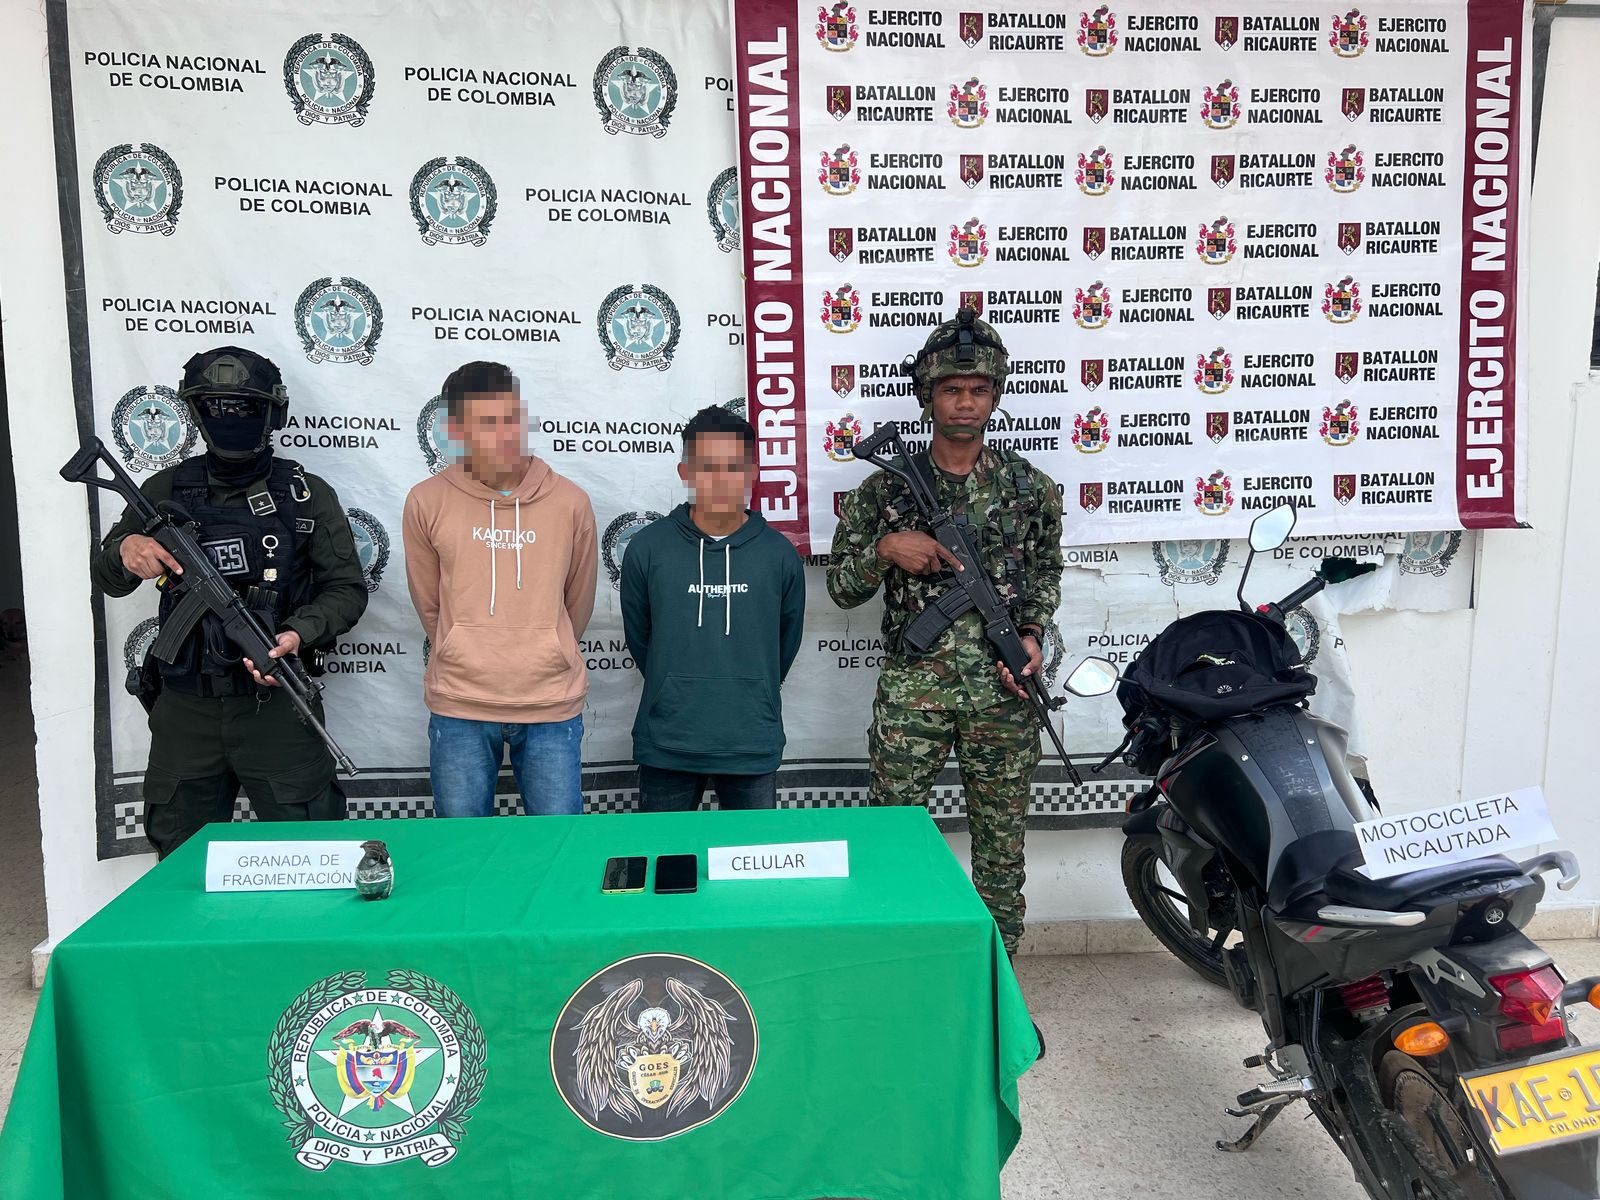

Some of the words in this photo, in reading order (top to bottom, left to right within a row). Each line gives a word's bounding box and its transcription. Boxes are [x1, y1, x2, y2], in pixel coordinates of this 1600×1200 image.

[868, 10, 943, 26] EJERCITO
[988, 13, 1066, 30] BATALLON
[1127, 15, 1199, 31] EJERCITO
[1243, 16, 1320, 31] BATALLON
[1378, 18, 1447, 32] EJERCITO
[866, 31, 946, 48] NACIONAL
[989, 35, 1064, 50] RICAURTE
[1124, 36, 1202, 52] NACIONAL
[1243, 36, 1317, 51] RICAURTE
[1375, 37, 1450, 53] NACIONAL
[84, 52, 161, 68] POLICIA
[167, 55, 266, 74] NACIONAL
[294, 45, 318, 75] REPUBLICA
[338, 46, 363, 76] COLOMBIA
[110, 73, 133, 87] DE
[139, 75, 244, 92] COLOMBIA
[404, 67, 477, 83] POLICIA
[483, 71, 577, 87] NACIONAL
[427, 88, 451, 101] DE
[457, 89, 555, 106] COLOMBIA
[856, 85, 936, 101] BATALLON
[998, 88, 1069, 102] EJERCITO
[1113, 89, 1191, 104] BATALLON
[1250, 89, 1321, 103] EJERCITO
[1369, 87, 1444, 103] BATALLON
[301, 93, 324, 112] POLICIA
[331, 94, 360, 114] NACIONAL
[857, 106, 934, 122] RICAURTE
[996, 108, 1072, 124] NACIONAL
[1113, 109, 1188, 124] RICAURTE
[1247, 109, 1323, 124] NACIONAL
[1369, 107, 1442, 123] RICAURTE
[748, 27, 791, 282] NACIONAL
[870, 153, 943, 169] EJERCITO
[988, 154, 1065, 170] BATALLON
[1124, 154, 1195, 170] EJERCITO
[1239, 154, 1316, 169] BATALLON
[1375, 152, 1444, 167] EJERCITO
[1471, 37, 1513, 272] NACIONAL
[215, 177, 290, 193] POLICIA
[295, 179, 392, 197] NACIONAL
[868, 174, 946, 190] NACIONAL
[989, 173, 1063, 189] RICAURTE
[1121, 175, 1198, 191] NACIONAL
[1240, 172, 1313, 188] RICAURTE
[1371, 172, 1447, 187] NACIONAL
[526, 188, 594, 203] POLICIA
[601, 189, 691, 206] NACIONAL
[240, 199, 265, 211] DE
[271, 199, 371, 216] COLOMBIA
[549, 208, 571, 222] DE
[577, 208, 671, 224] COLOMBIA
[857, 226, 936, 242] BATALLON
[998, 226, 1068, 241] EJERCITO
[1110, 225, 1187, 241] BATALLON
[1246, 223, 1317, 239] EJERCITO
[1365, 221, 1440, 236] BATALLON
[995, 246, 1070, 262] NACIONAL
[1111, 245, 1184, 261] RICAURTE
[1243, 243, 1320, 259] NACIONAL
[1365, 239, 1438, 255] RICAURTE
[858, 247, 934, 265] RICAURTE
[987, 290, 1063, 305] BATALLON
[1122, 287, 1193, 303] EJERCITO
[1236, 286, 1313, 301] BATALLON
[1371, 282, 1441, 298] EJERCITO
[102, 298, 176, 313] POLICIA
[181, 300, 276, 315] NACIONAL
[871, 291, 944, 307] EJERCITO
[411, 307, 483, 322] POLICIA
[489, 309, 581, 324] NACIONAL
[988, 308, 1060, 324] RICAURTE
[1119, 307, 1195, 323] NACIONAL
[1236, 303, 1310, 320] RICAURTE
[1368, 302, 1444, 318] NACIONAL
[126, 318, 148, 331] DE
[155, 319, 254, 334] COLOMBIA
[869, 312, 943, 327] NACIONAL
[434, 327, 458, 340] DE
[464, 327, 560, 342] COLOMBIA
[1108, 356, 1185, 372] BATALLON
[1244, 353, 1314, 369] EJERCITO
[1363, 350, 1438, 365] BATALLON
[1009, 359, 1066, 374] JERCITO
[1363, 367, 1436, 382] RICAURTE
[1002, 379, 1069, 395] ACIONAL
[1109, 374, 1182, 391] RICAURTE
[1240, 372, 1316, 388] NACIONAL
[860, 383, 916, 398] RICAUR
[1466, 289, 1506, 499] EJERCITO
[755, 301, 798, 522] EJERCITO
[1233, 409, 1310, 425] BATALLON
[1369, 405, 1438, 421] EJERCITO
[305, 416, 401, 431] NACIONAL
[540, 420, 601, 434] OLICIA
[606, 421, 684, 435] NACIONA
[987, 416, 1061, 432] BATALLON
[1120, 412, 1191, 428] EJERCITO
[1117, 431, 1193, 448] NACIONAL
[1234, 426, 1308, 442] RICAURTE
[1366, 424, 1440, 440] NACIONAL
[280, 434, 379, 449] COLOMBIA
[553, 439, 577, 452] DE
[582, 439, 675, 453] COLOMBIA
[988, 437, 1059, 452] RICAURTE
[1107, 479, 1184, 495] BATALLON
[1243, 475, 1313, 491] EJERCITO
[1361, 472, 1434, 487] BATALLON
[1361, 489, 1433, 505] RICAURTE
[1108, 498, 1182, 514] RICAURTE
[472, 526, 536, 544] KAOTIKO
[1273, 548, 1294, 559] DE
[1299, 545, 1385, 559] COLOMBIA
[688, 583, 749, 594] AUTHENTIC
[818, 639, 883, 652] POLICIA
[1088, 634, 1149, 647] POLICIA
[326, 642, 407, 656] ACIONAL
[1107, 651, 1128, 663] DE
[327, 660, 387, 674] OMBIA
[838, 656, 860, 668] DE
[1361, 796, 1519, 844] MOTOCICLETA
[1383, 824, 1511, 864] INCAUTADA
[238, 854, 312, 868] GRANADA
[320, 854, 340, 866] DE
[731, 853, 805, 871] CELULAR
[222, 870, 353, 886] FRAGMENTACIÓN
[293, 997, 353, 1063] REPUBLICA
[366, 991, 388, 1002] DE
[403, 996, 459, 1058] COLOMBIA
[639, 1061, 669, 1071] GOES
[1477, 1076, 1567, 1132] KAE
[1568, 1063, 1600, 1112] 1
[307, 1103, 361, 1141] POLICIA
[380, 1099, 449, 1142] NACIONAL
[1549, 1115, 1600, 1134] COLOMB
[314, 1140, 350, 1159] DIOS
[362, 1150, 372, 1161] Y
[384, 1137, 439, 1159] PATRIA
